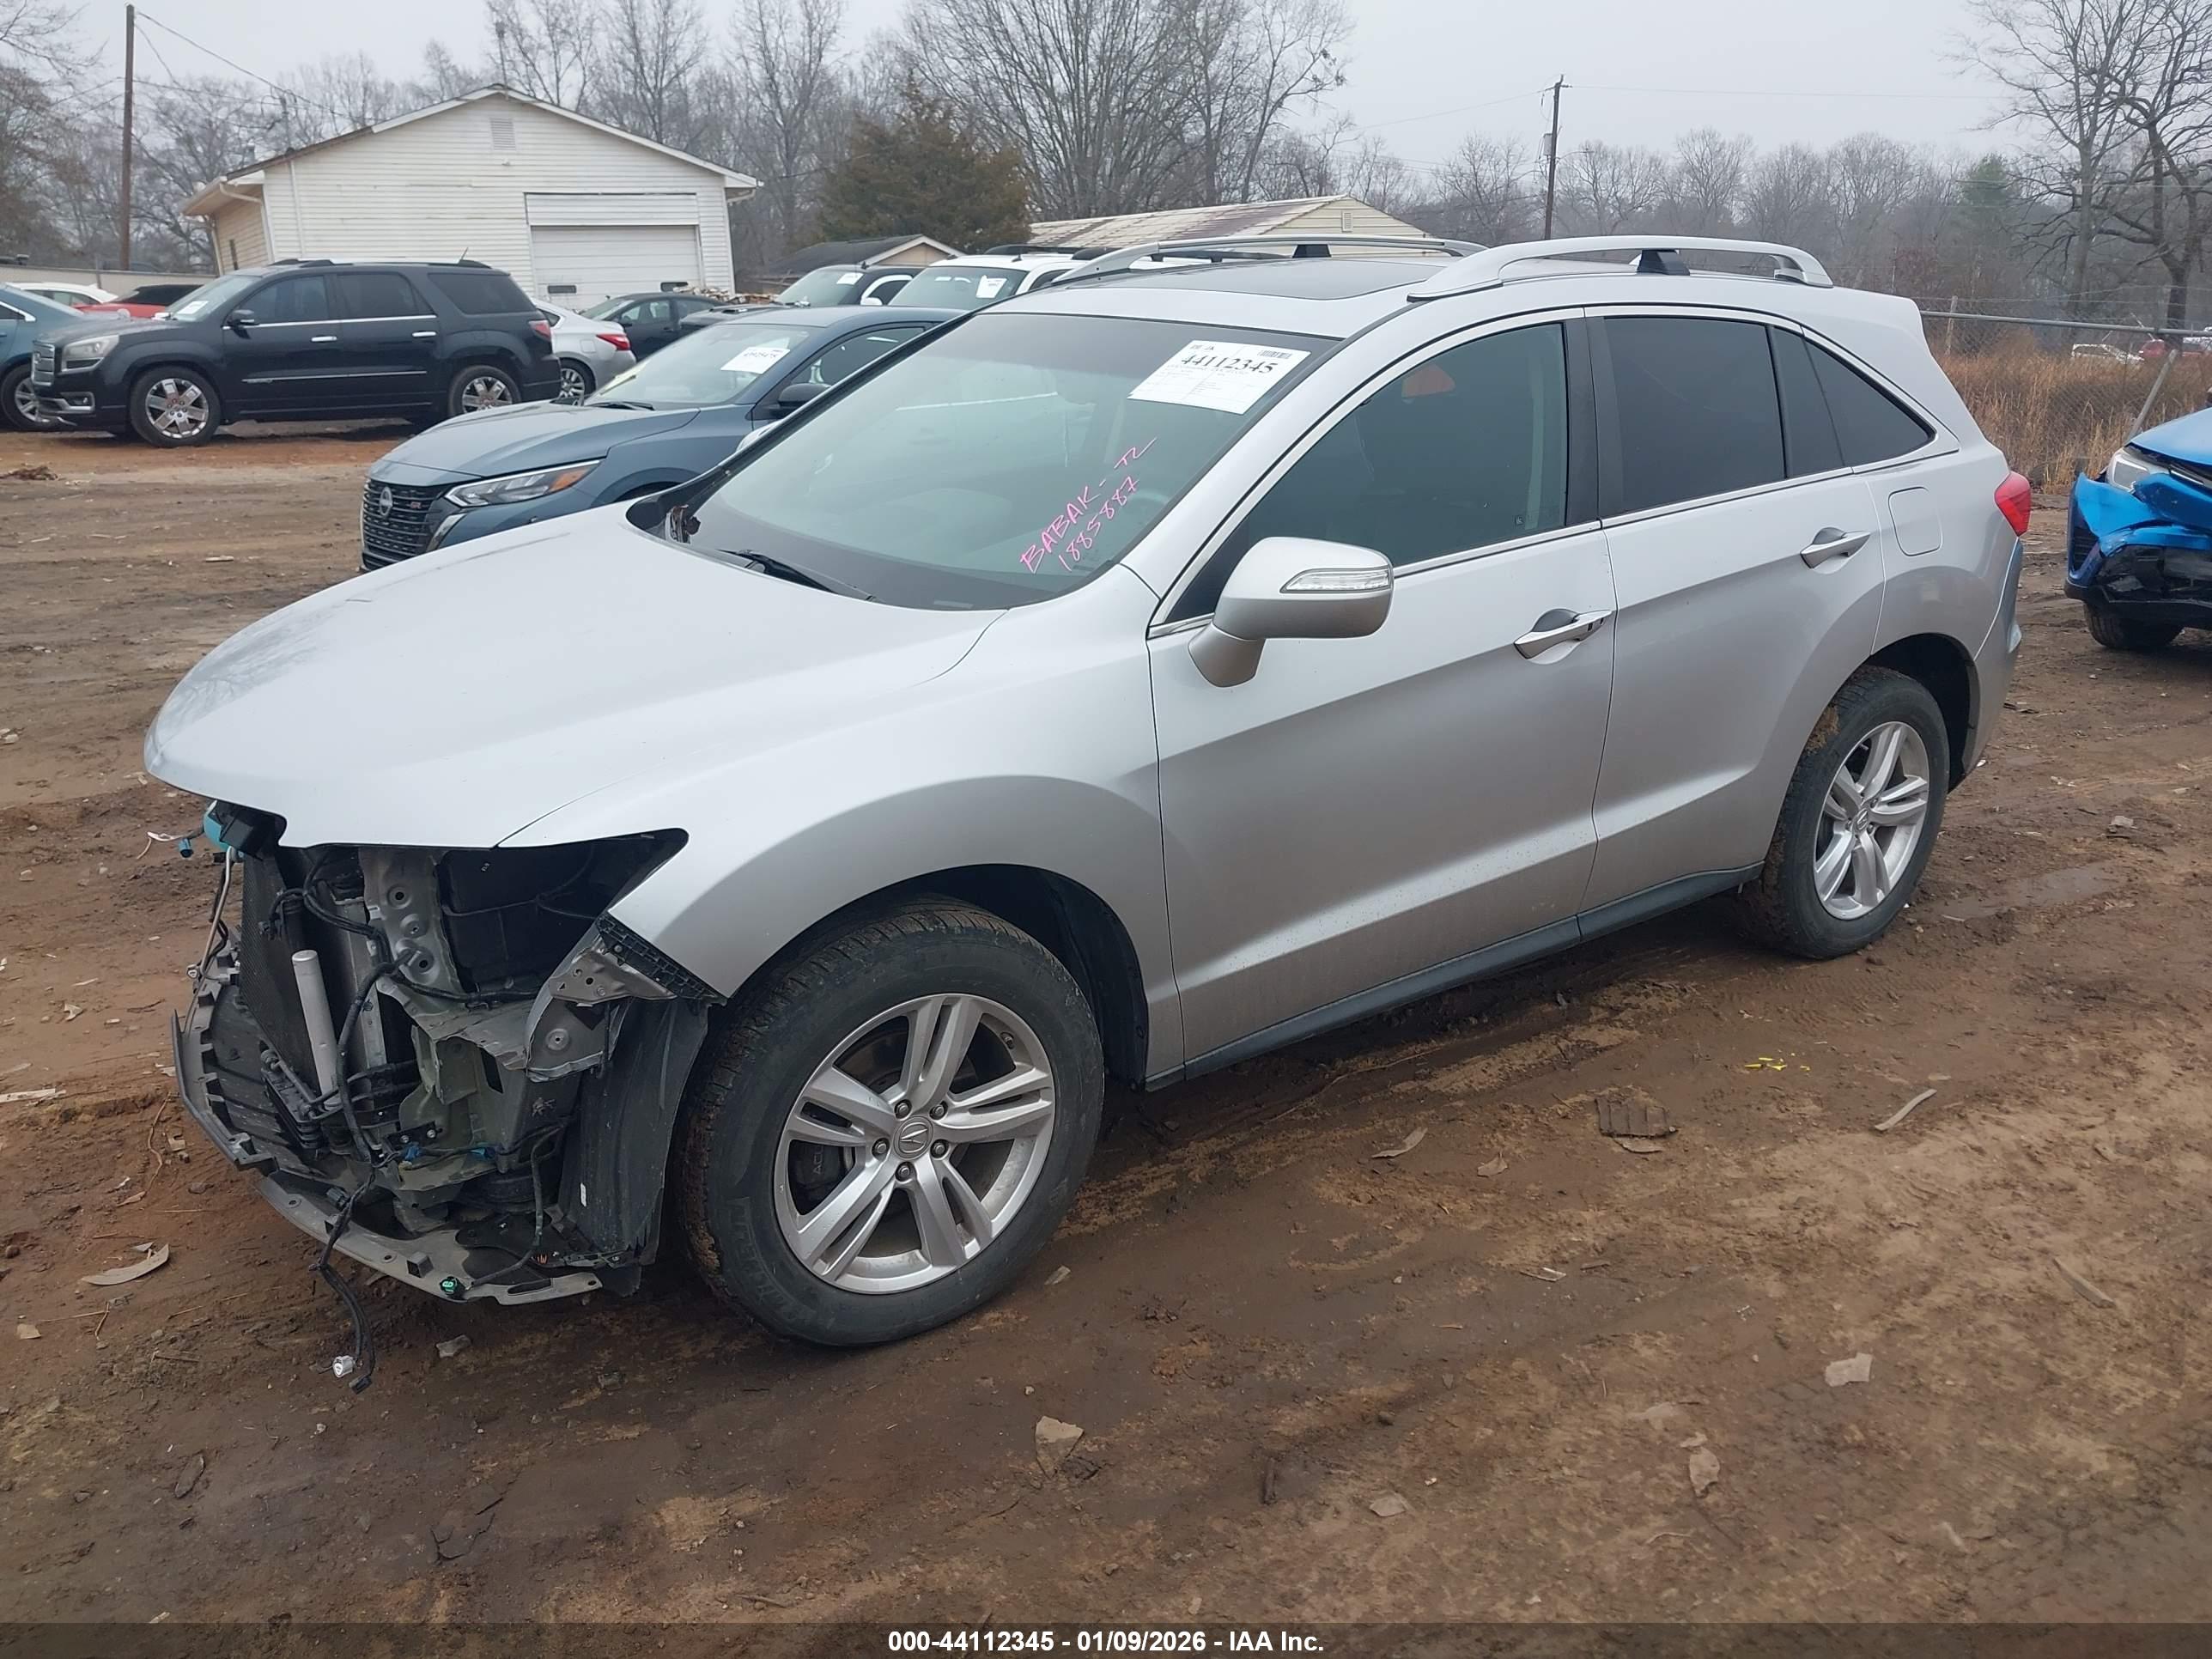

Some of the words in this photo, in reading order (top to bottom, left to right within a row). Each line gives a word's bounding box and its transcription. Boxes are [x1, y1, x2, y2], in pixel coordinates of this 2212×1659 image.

[1181, 353, 1279, 374] 44112345
[1019, 485, 1102, 574] BABAK
[1058, 475, 1139, 573] 1885887
